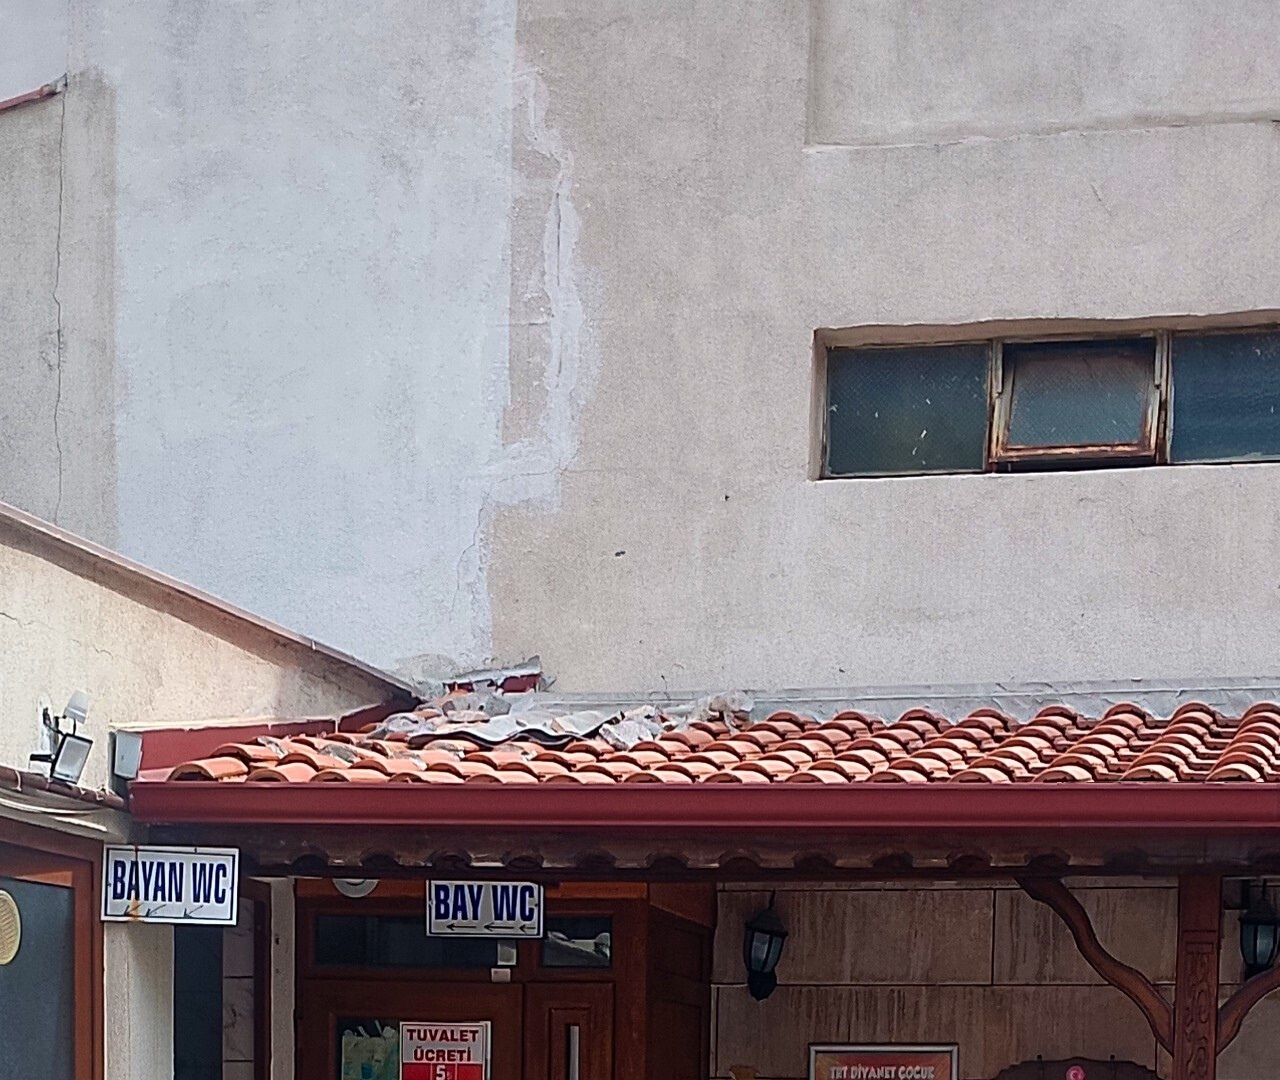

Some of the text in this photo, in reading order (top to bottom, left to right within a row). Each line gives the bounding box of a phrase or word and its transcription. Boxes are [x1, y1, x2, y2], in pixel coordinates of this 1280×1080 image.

[112, 859, 227, 904] BAYAN WC
[434, 884, 535, 922] BAY WC
[406, 1028, 479, 1042] TUVALET
[413, 1045, 472, 1062] ÜCRETİ
